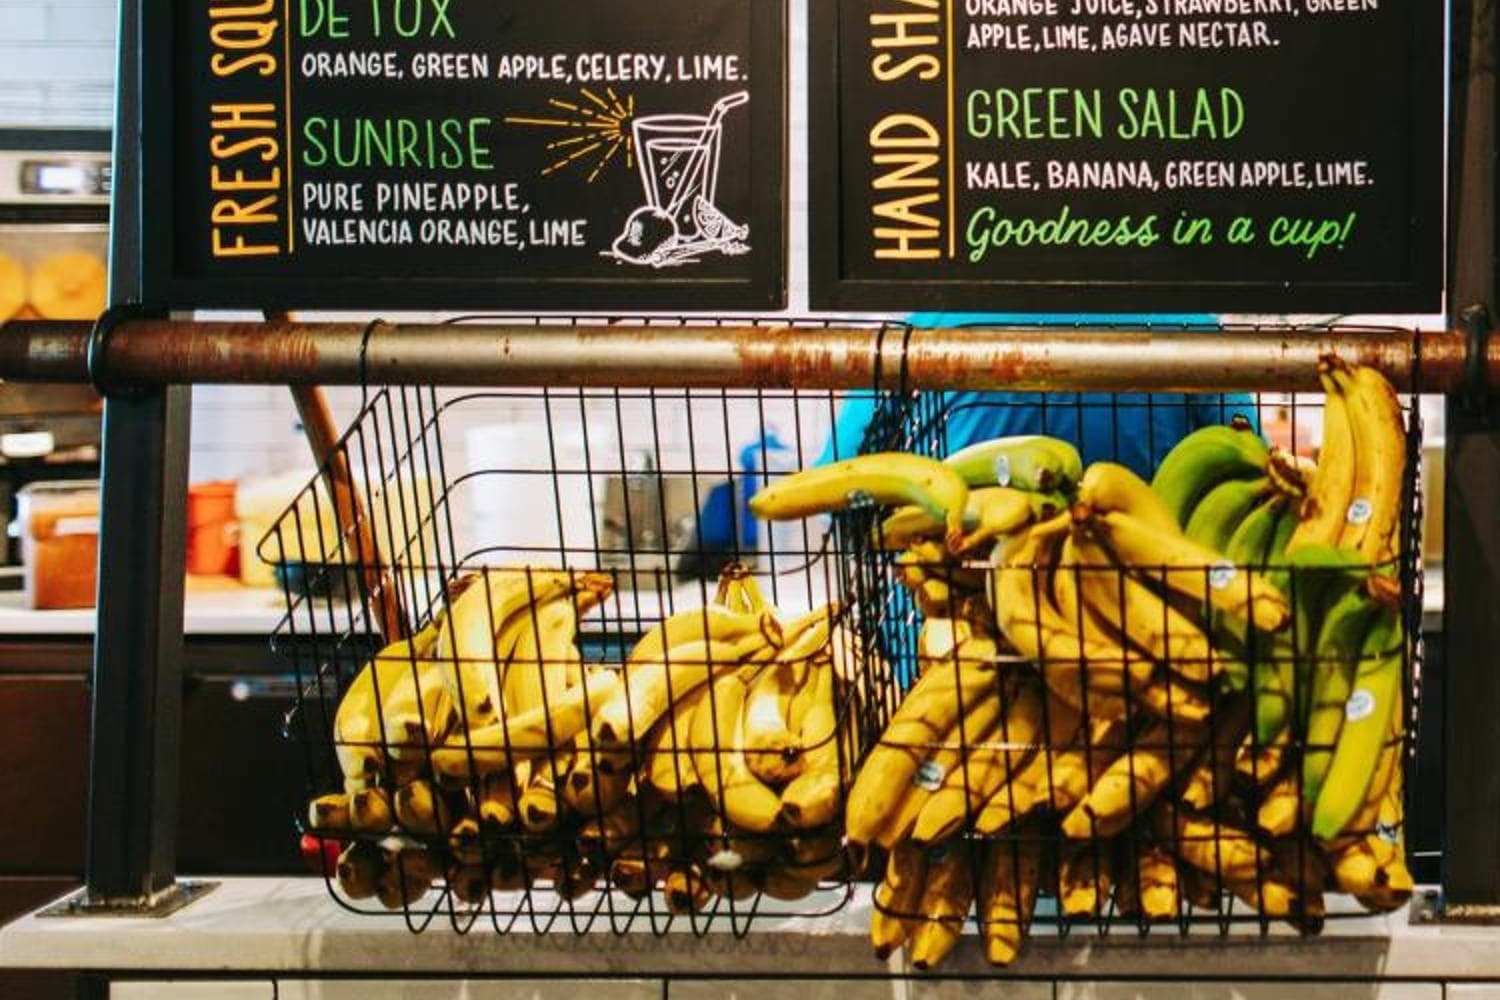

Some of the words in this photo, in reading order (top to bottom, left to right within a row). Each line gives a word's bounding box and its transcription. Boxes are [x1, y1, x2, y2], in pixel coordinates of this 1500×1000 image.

[967, 87, 1103, 139] GREEN
[1117, 87, 1244, 140] SALAD
[303, 116, 494, 170] SUNRISE
[210, 103, 281, 257] FRESH
[303, 182, 363, 212] PURE
[869, 113, 941, 259] HAND
[302, 217, 413, 245] VALENCIA
[529, 219, 587, 247] LIME
[966, 205, 1160, 263] Goodness
[1172, 211, 1213, 245] in
[1227, 216, 1255, 244] a
[1268, 212, 1356, 259] cup!
